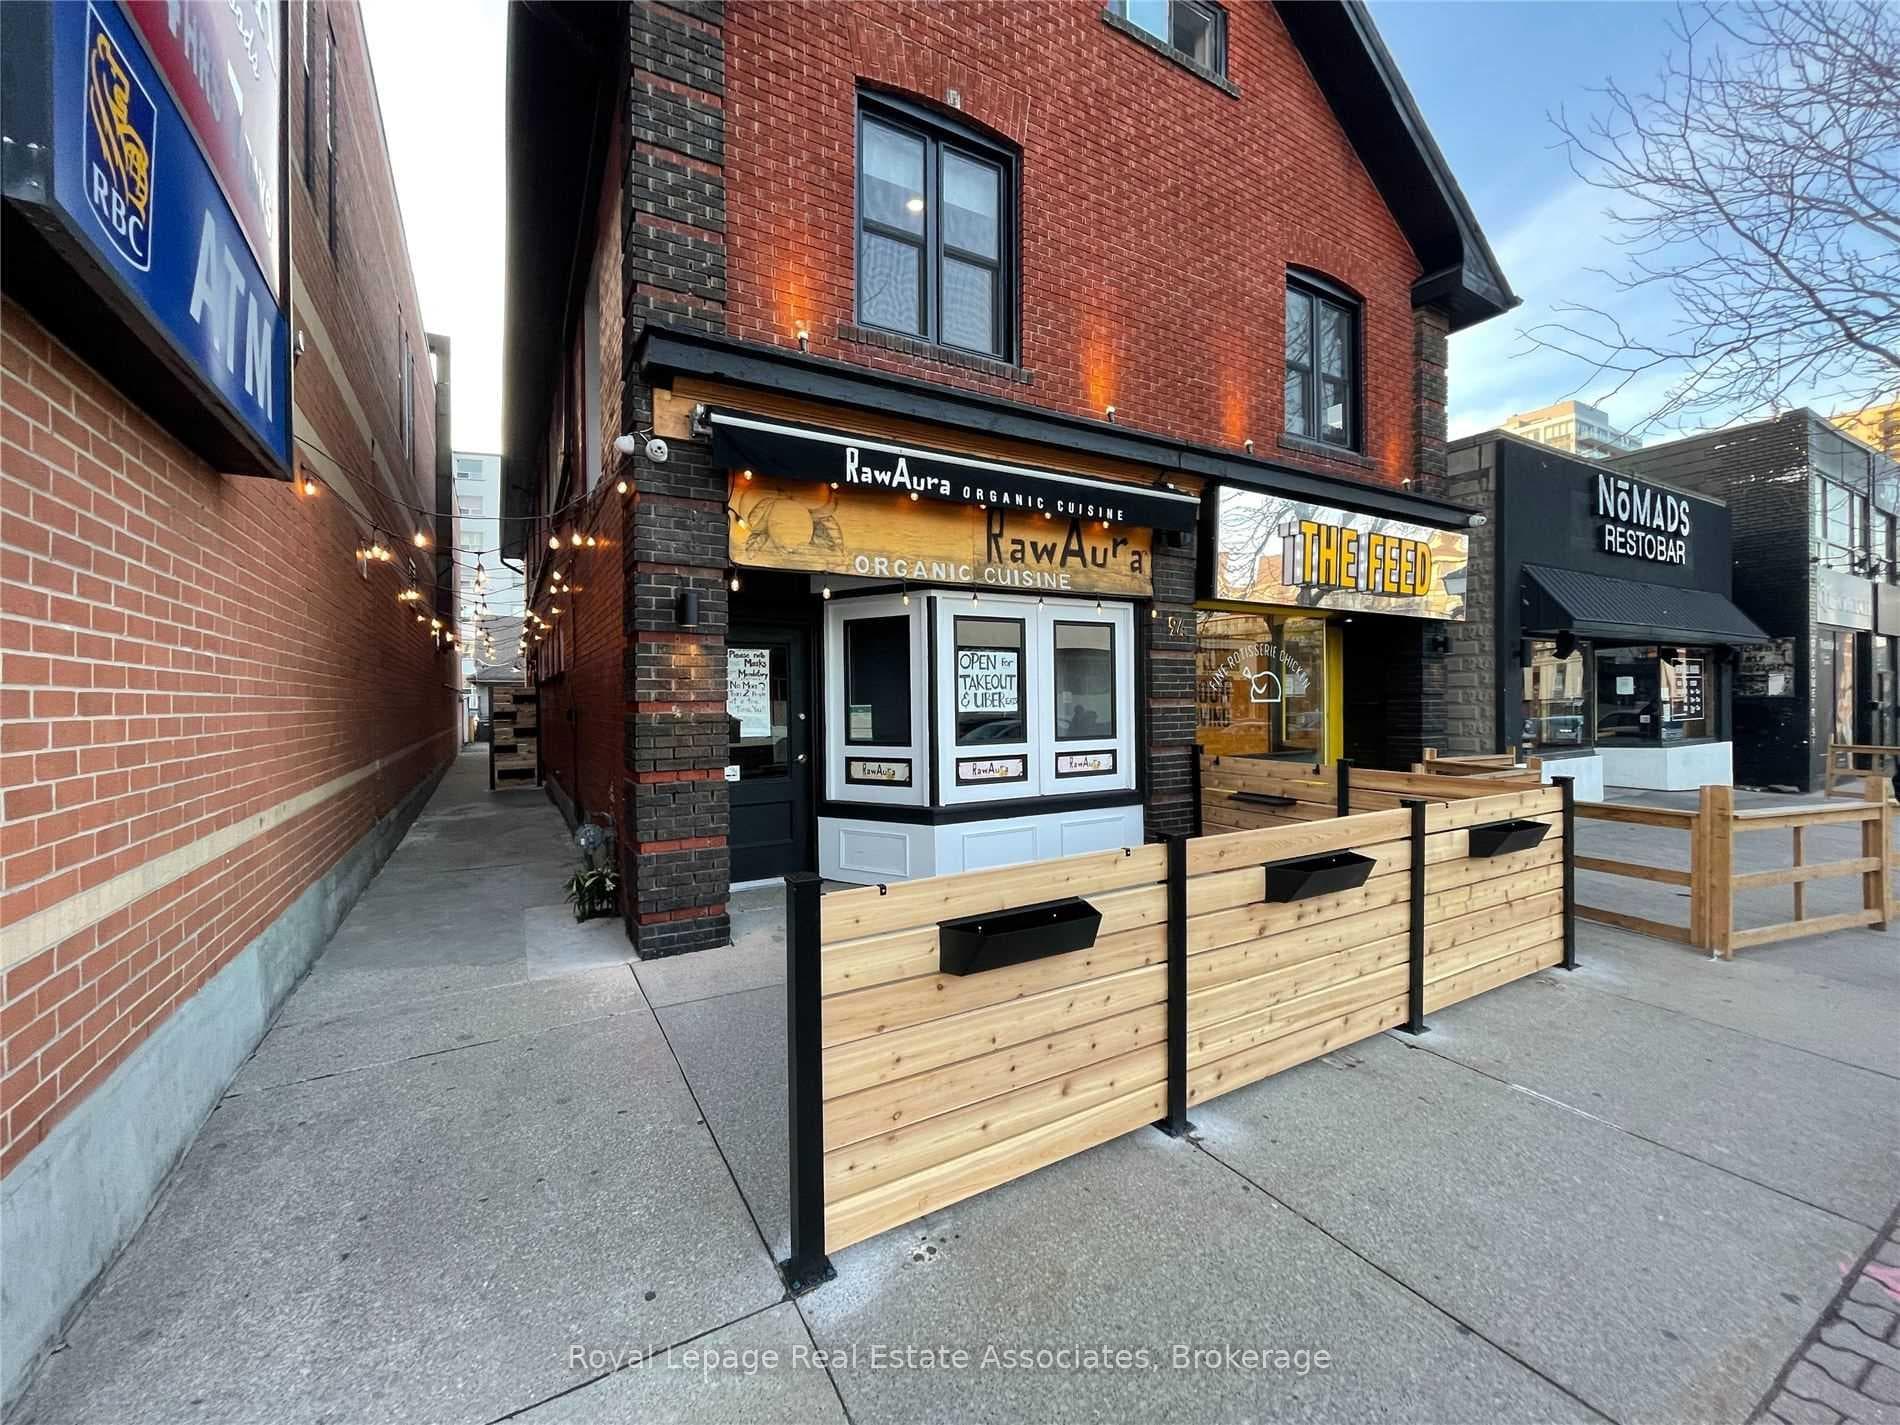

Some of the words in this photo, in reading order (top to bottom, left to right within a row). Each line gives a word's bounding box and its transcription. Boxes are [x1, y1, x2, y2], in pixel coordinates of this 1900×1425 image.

[92, 162, 145, 258] RBC
[189, 207, 273, 424] ATM
[845, 446, 951, 497] RawAura
[962, 485, 1045, 511] ORGANIC
[1057, 499, 1125, 522] CUISINE
[986, 508, 1149, 574] RawAura
[1298, 519, 1360, 589] THE
[1367, 532, 1433, 598] FEED
[1604, 523, 1687, 566] RESTOBAR
[854, 554, 972, 582] ORGANIC
[984, 566, 1073, 590] CUISINE
[959, 653, 997, 670] OPEN
[959, 673, 1017, 691] TAKEOUT
[1208, 664, 1229, 692] FINE
[1226, 643, 1278, 671] ROTISSERIE
[961, 691, 970, 708] &
[973, 691, 1006, 708] UBER
